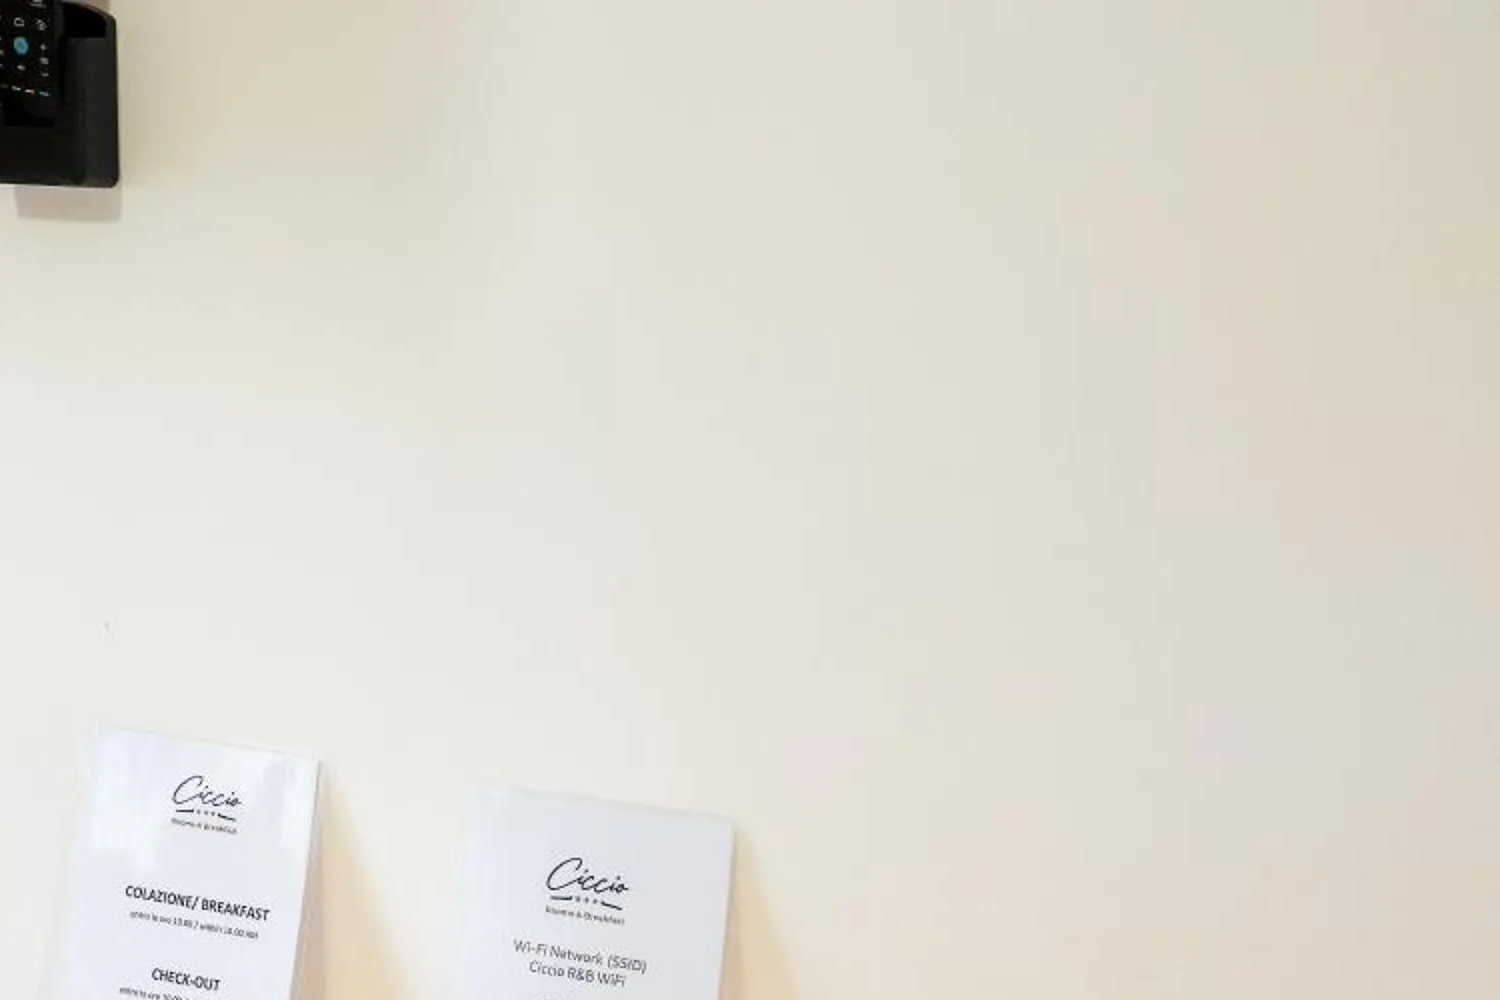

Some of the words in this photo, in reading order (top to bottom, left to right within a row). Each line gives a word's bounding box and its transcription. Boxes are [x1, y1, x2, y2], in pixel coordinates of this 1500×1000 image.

[172, 775, 242, 807] Ciccio
[546, 857, 628, 894] Ciccio
[125, 885, 199, 911] COLAZIONE/
[201, 897, 270, 922] BREAKFAST
[513, 938, 548, 956] Wi-Fi
[549, 945, 603, 966] Network
[151, 967, 221, 991] CHECK-OUT
[529, 959, 565, 977] Ciccio
[567, 966, 595, 983] R&B
[597, 971, 626, 988] WiFi
